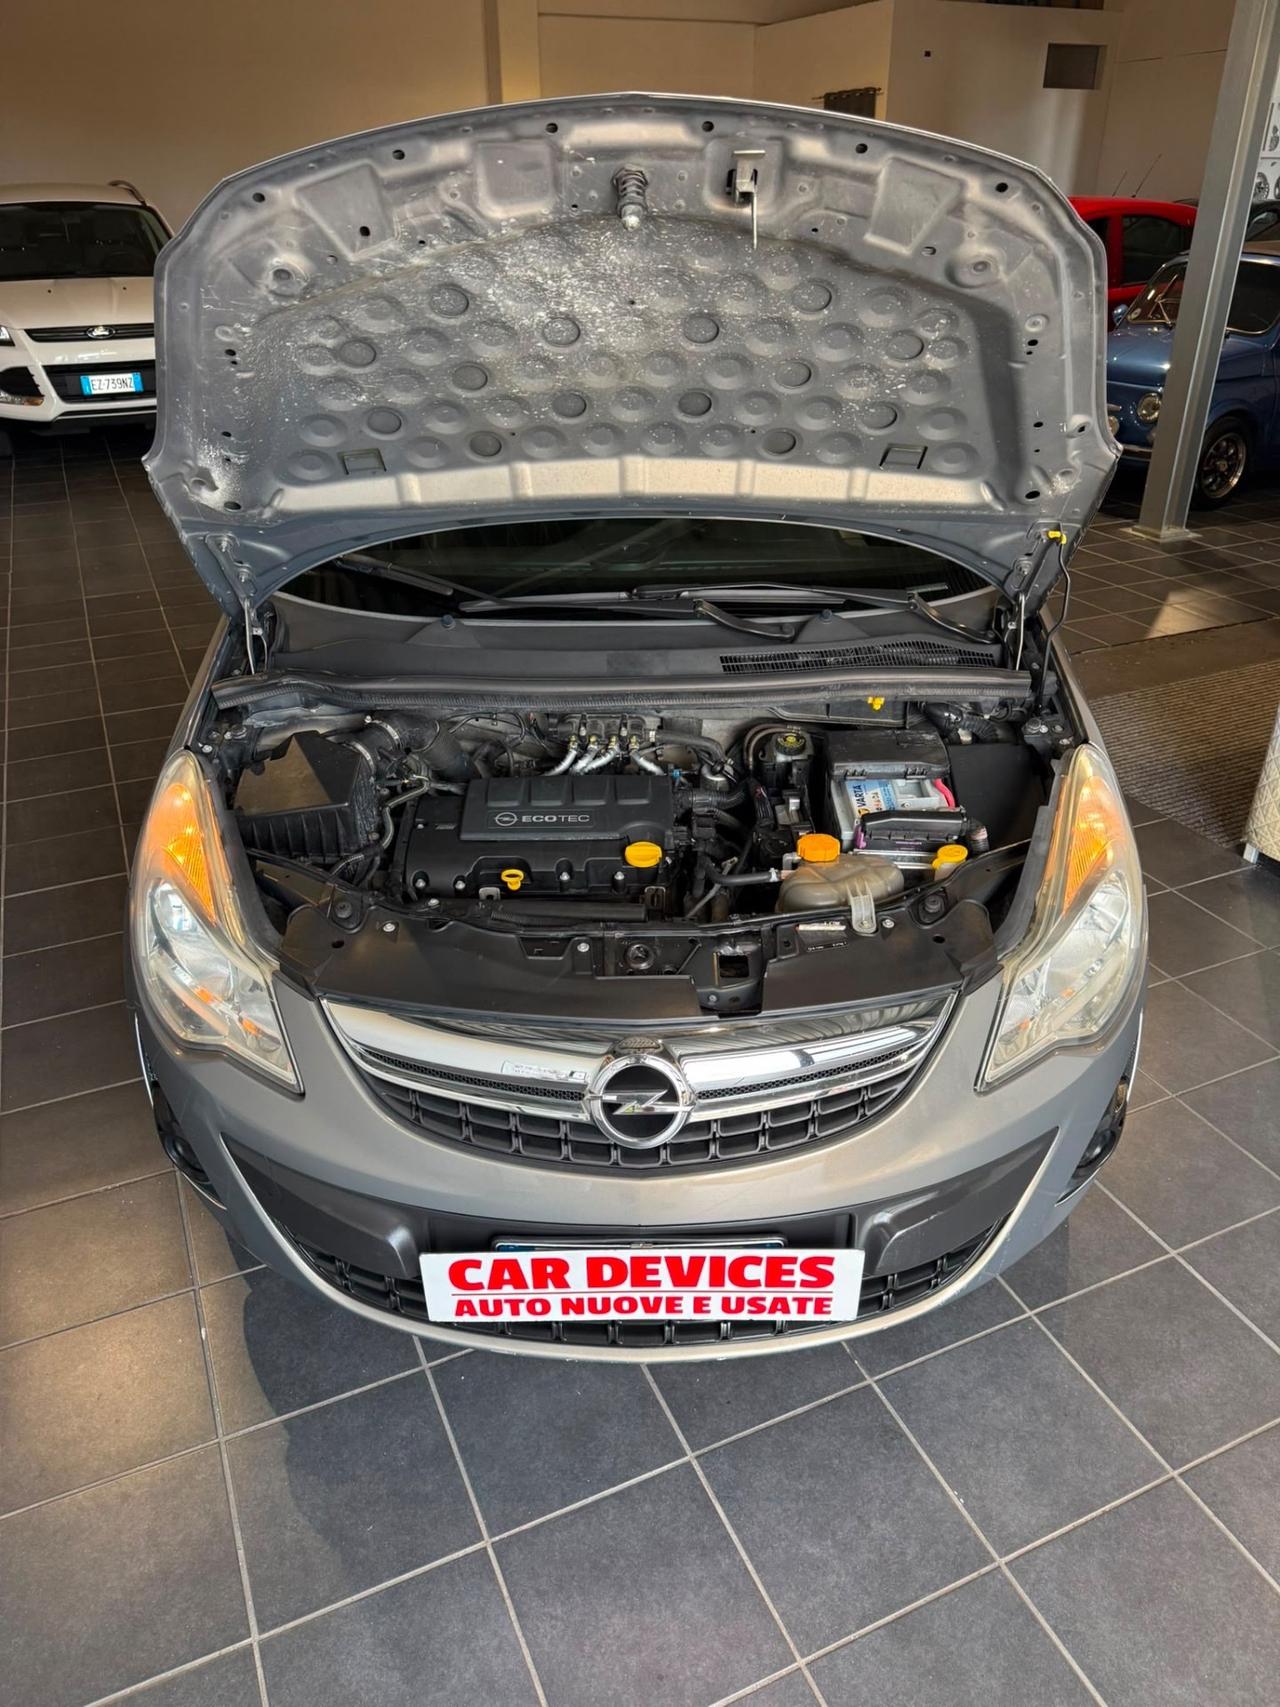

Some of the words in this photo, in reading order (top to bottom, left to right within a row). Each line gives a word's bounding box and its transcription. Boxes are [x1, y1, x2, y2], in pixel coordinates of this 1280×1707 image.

[852, 784, 867, 808] VARTA
[448, 1258, 571, 1291] CAR
[586, 1256, 835, 1290] DEVICES
[455, 1298, 552, 1317] AUTO
[561, 1297, 683, 1316] NUOVE
[693, 1296, 711, 1315] E
[721, 1296, 833, 1315] USATE
